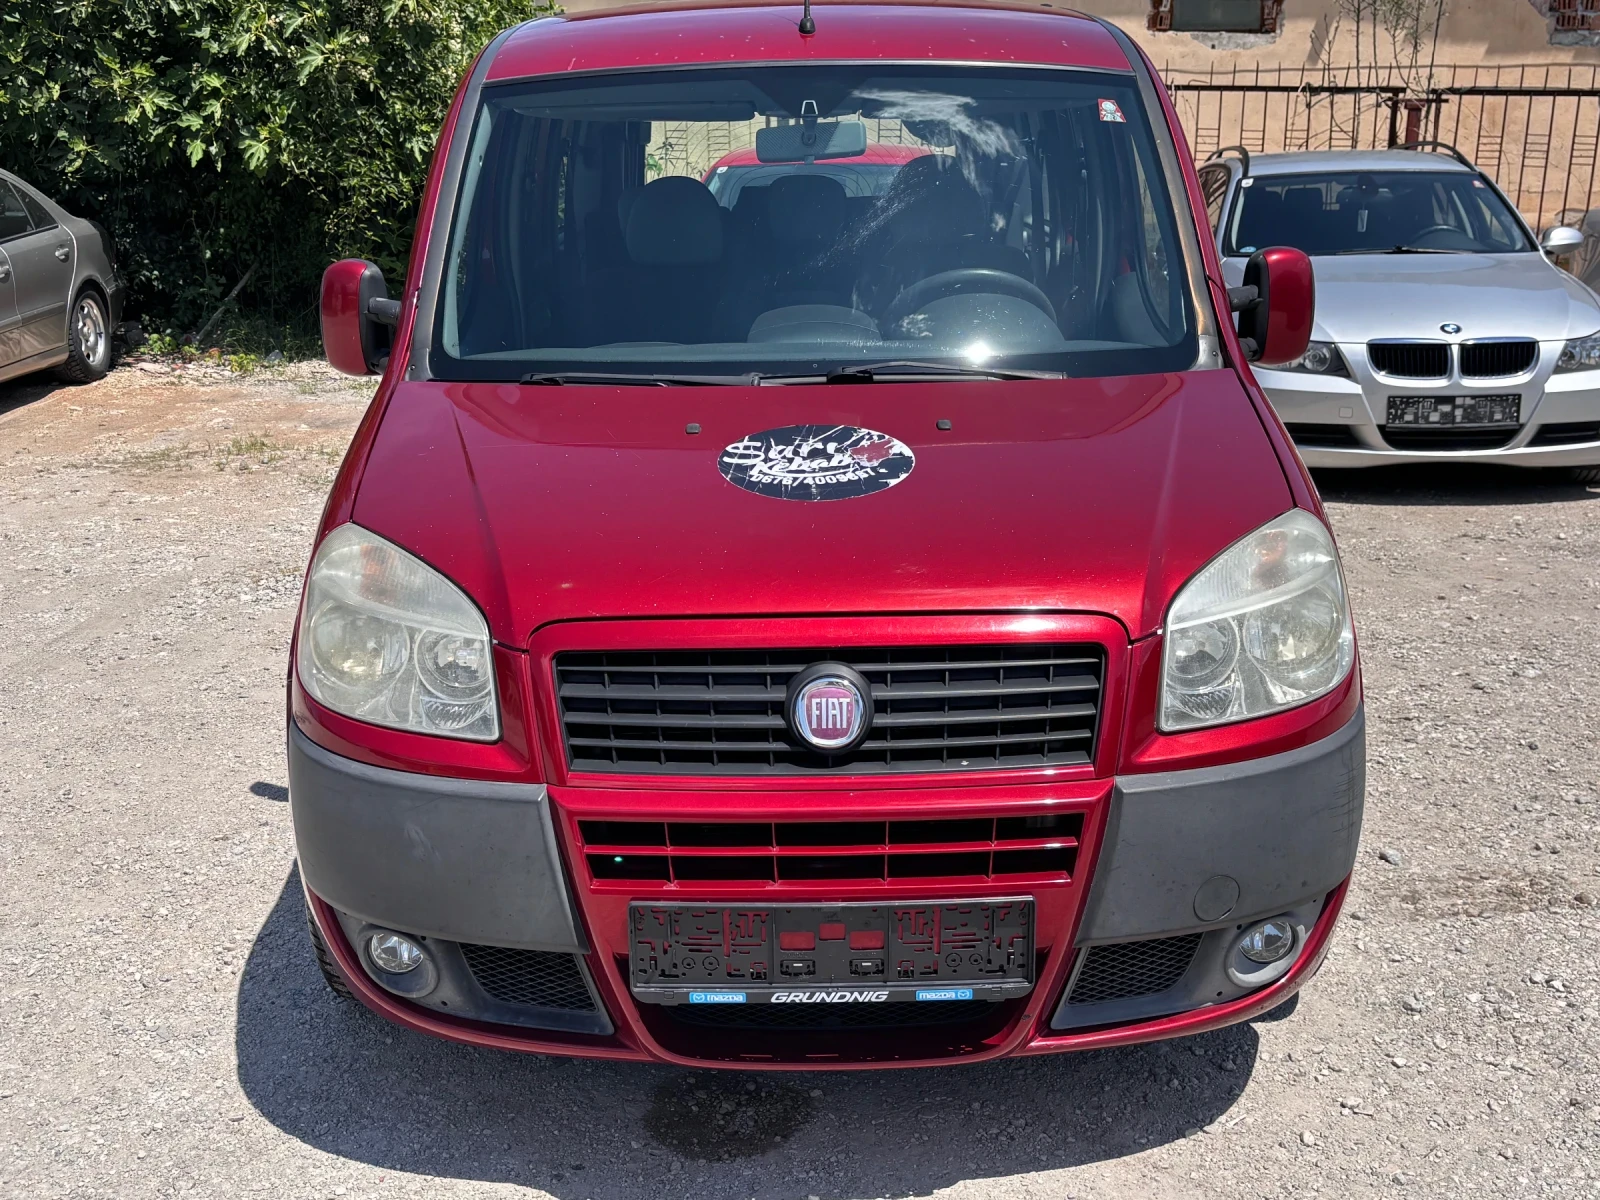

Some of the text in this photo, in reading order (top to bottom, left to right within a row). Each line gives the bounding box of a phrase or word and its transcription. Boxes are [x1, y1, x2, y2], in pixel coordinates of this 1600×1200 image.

[811, 698, 851, 729] FIAT
[707, 993, 744, 1002] mazda
[770, 990, 890, 1003] GRUNDNIG
[919, 991, 956, 1000] mazda
